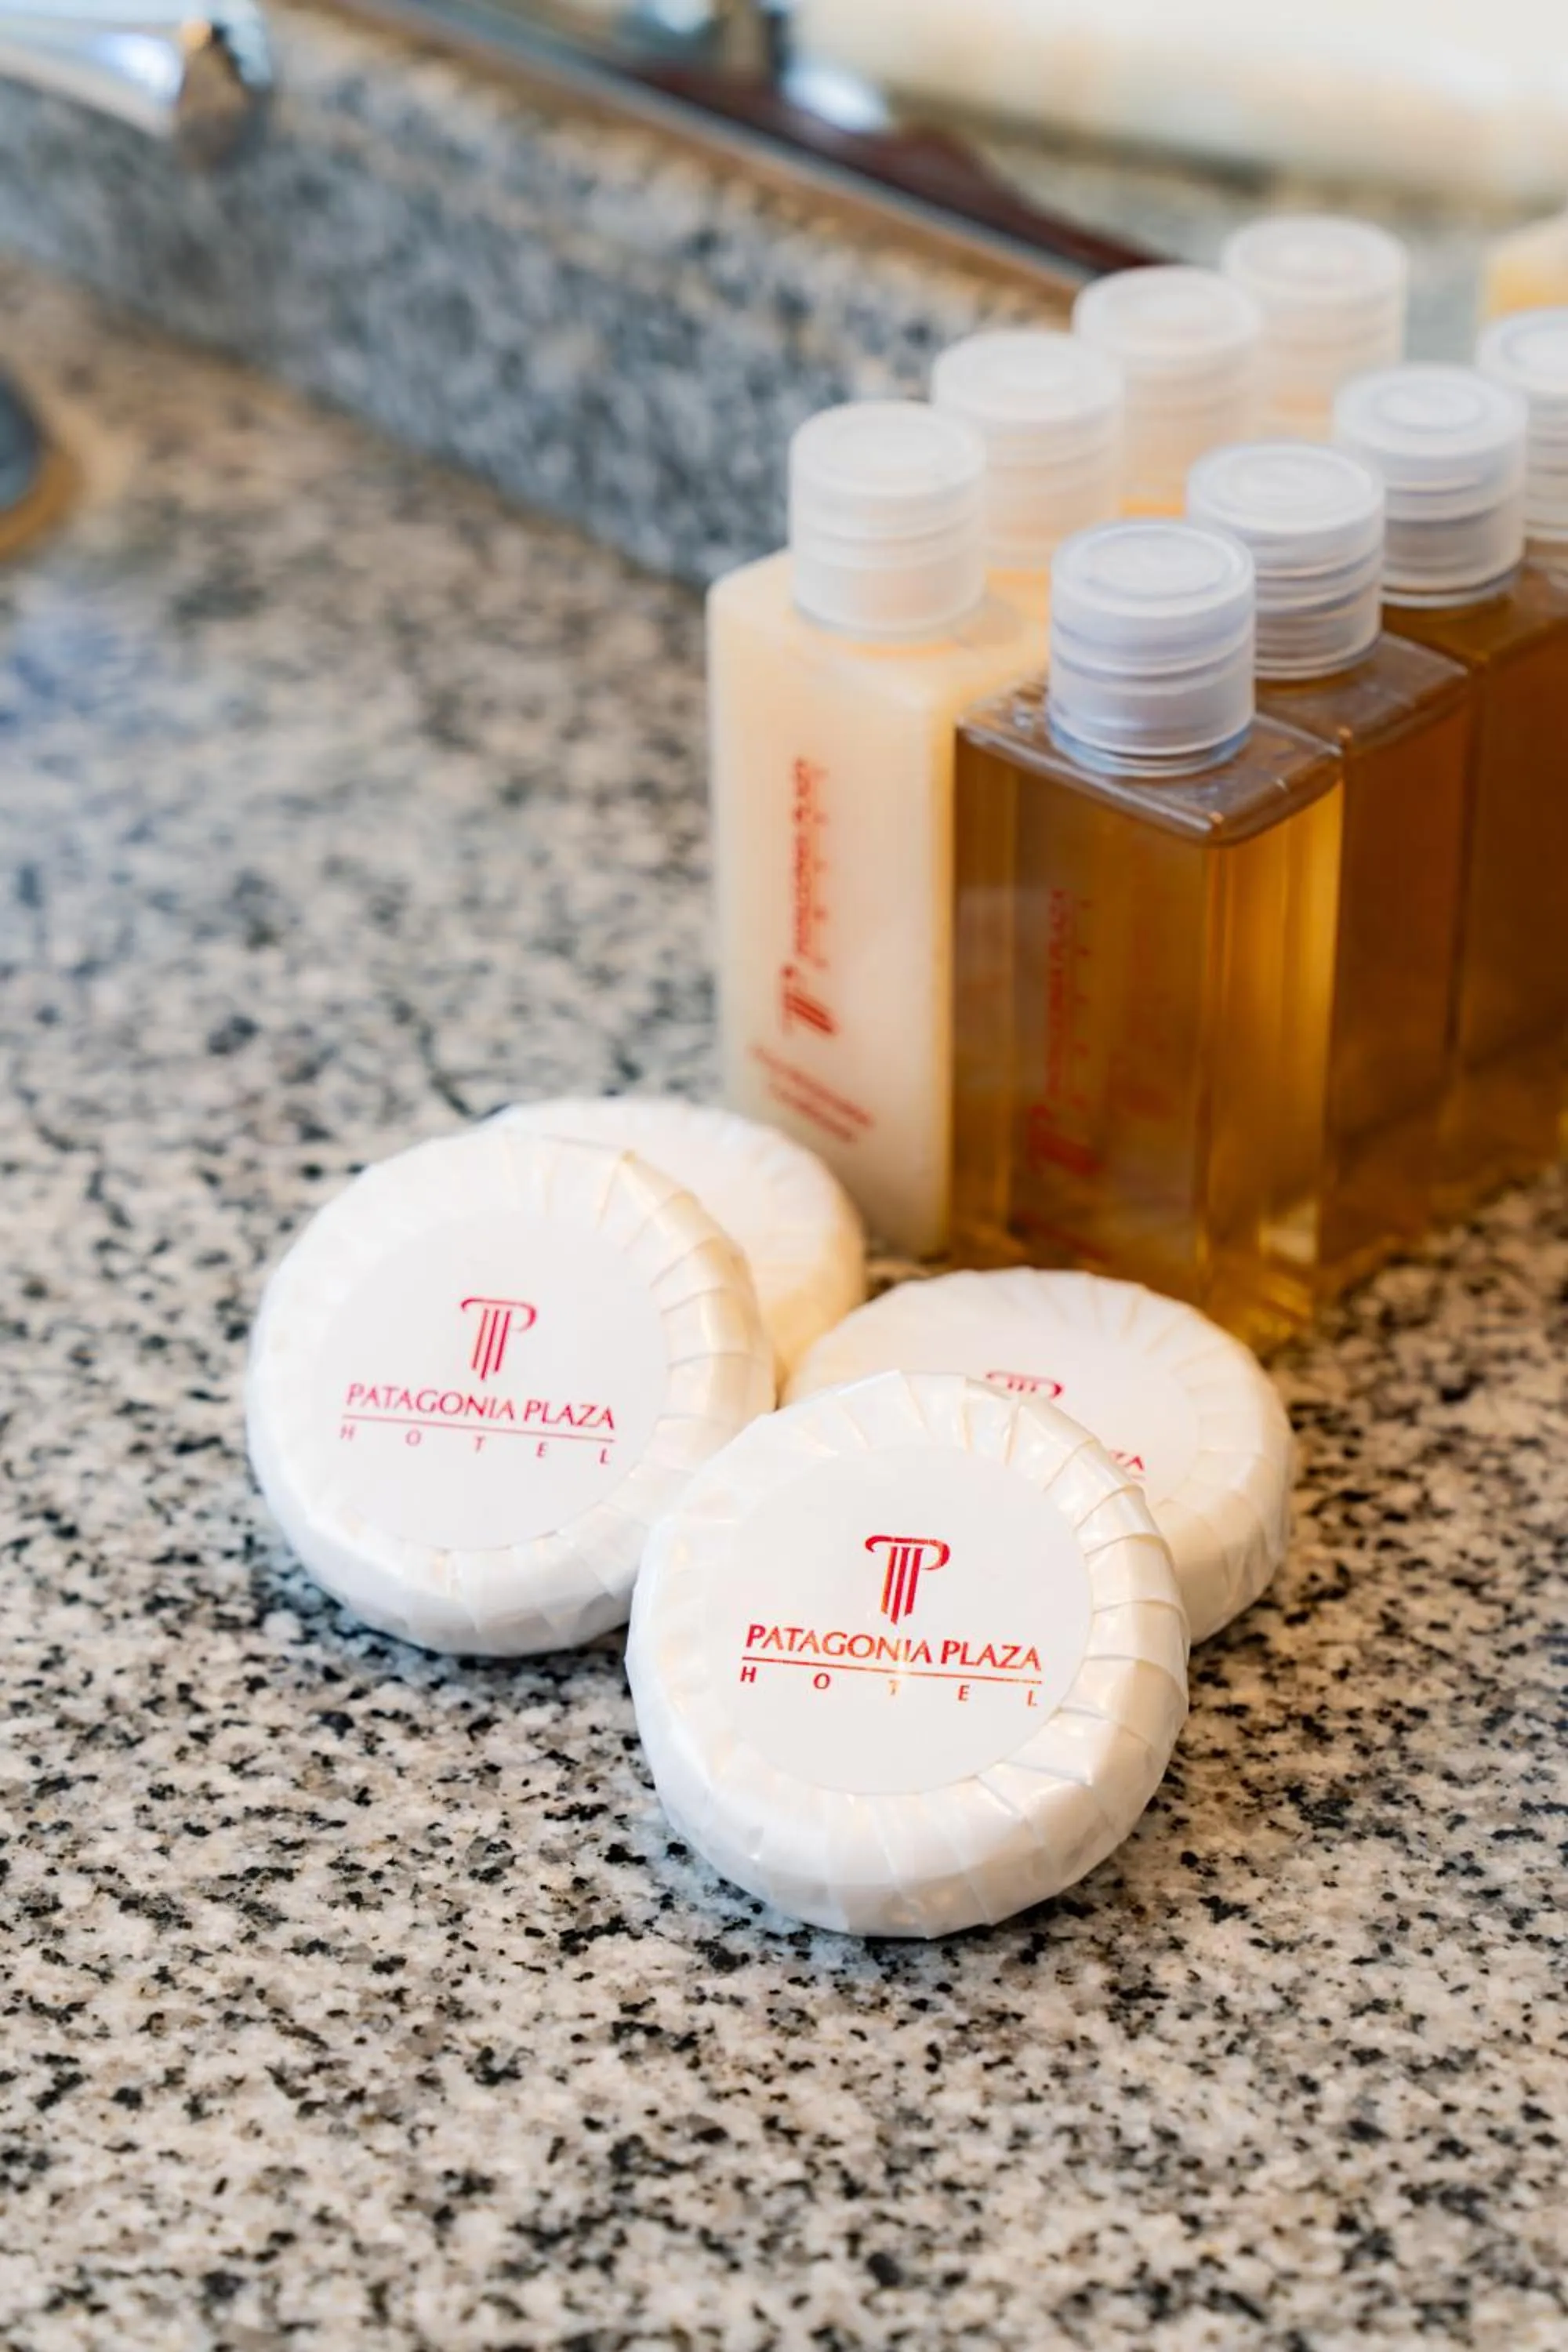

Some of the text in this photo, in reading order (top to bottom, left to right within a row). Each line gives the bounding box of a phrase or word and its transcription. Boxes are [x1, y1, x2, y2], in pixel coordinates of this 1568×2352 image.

[345, 1382, 615, 1429] PATAGONIA PLAZA
[340, 1425, 610, 1465] HOTEL
[746, 1624, 1042, 1671] PATAGONIA PLAZA
